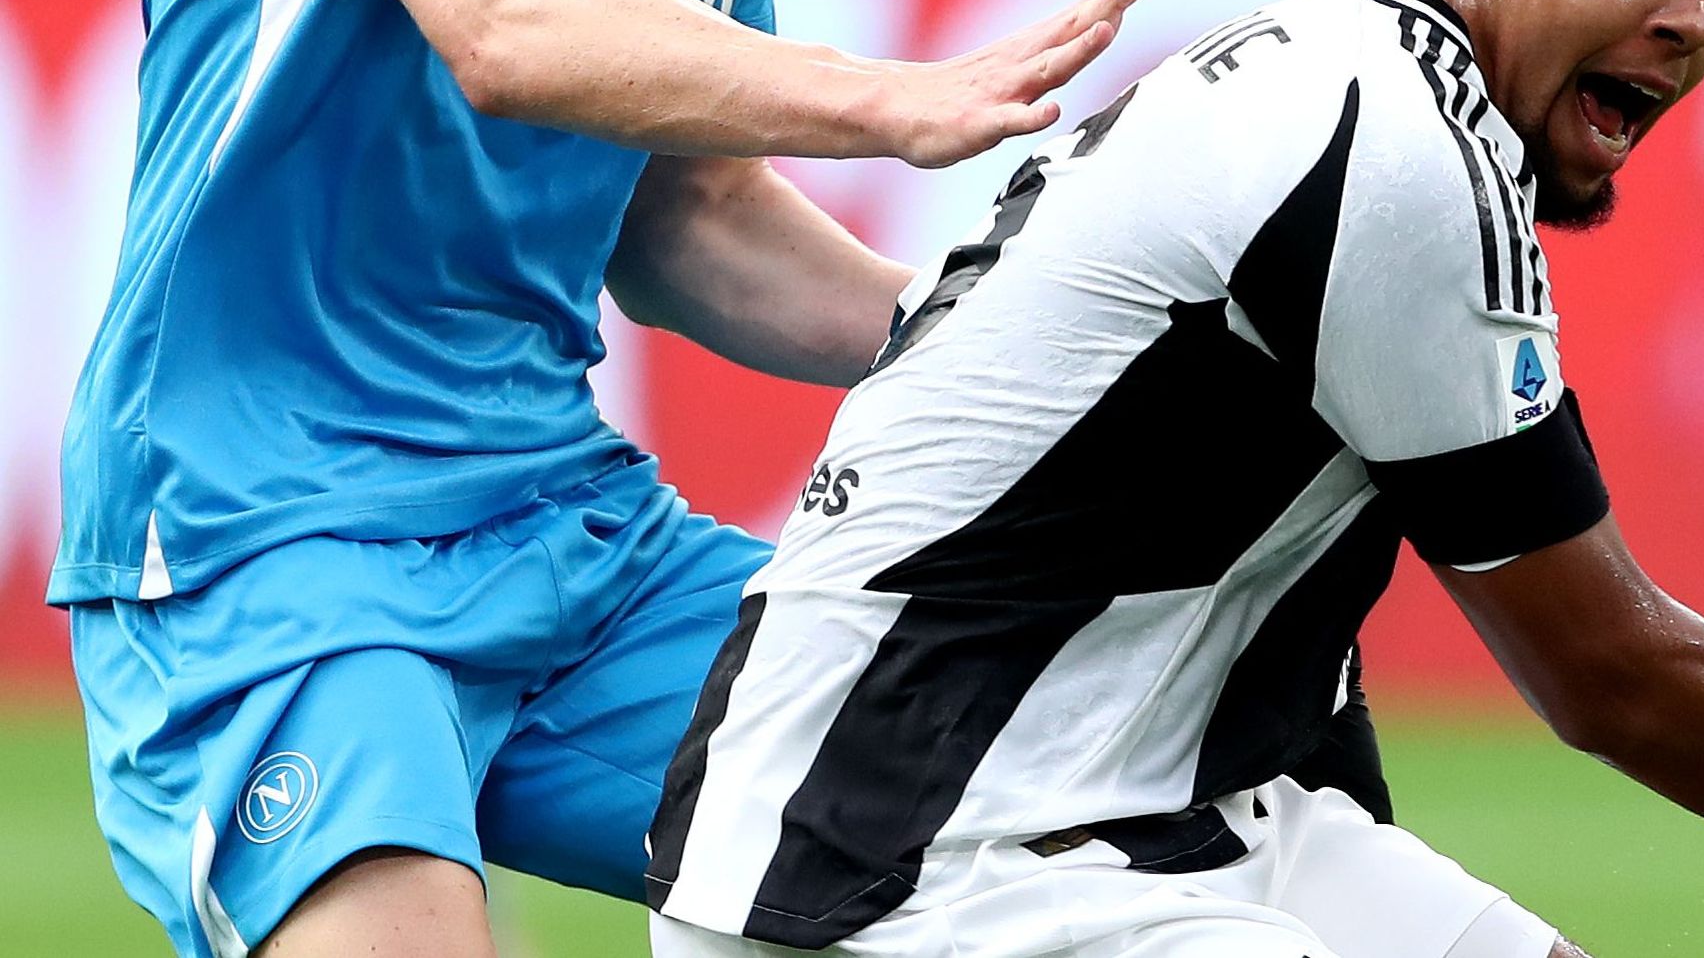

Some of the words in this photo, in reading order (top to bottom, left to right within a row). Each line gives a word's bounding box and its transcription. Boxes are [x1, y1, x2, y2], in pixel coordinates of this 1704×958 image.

[1514, 402, 1545, 424] SERIE
[801, 462, 860, 517] es
[251, 770, 293, 823] N
